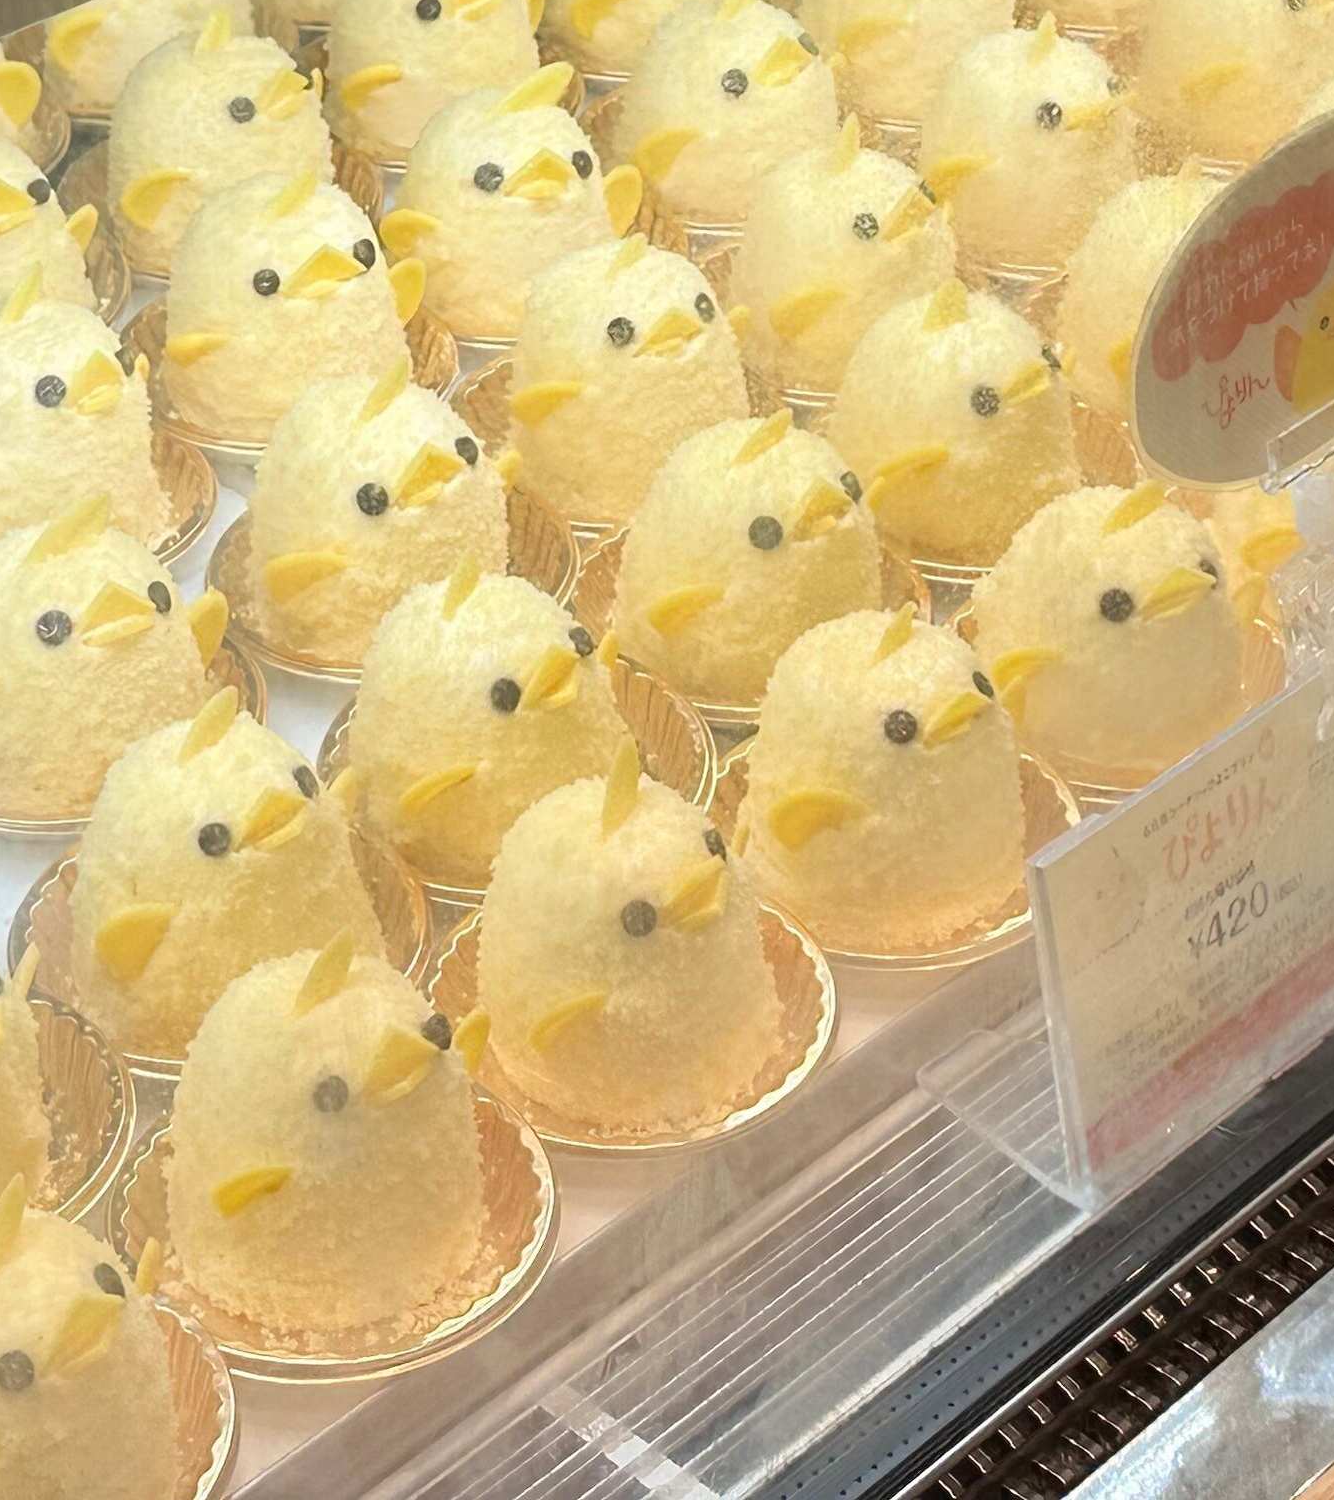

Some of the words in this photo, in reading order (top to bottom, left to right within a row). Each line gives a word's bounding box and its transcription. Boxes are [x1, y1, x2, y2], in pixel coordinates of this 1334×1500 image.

[1162, 777, 1285, 883] ぴよりん
[1188, 881, 1268, 960] ¥420
